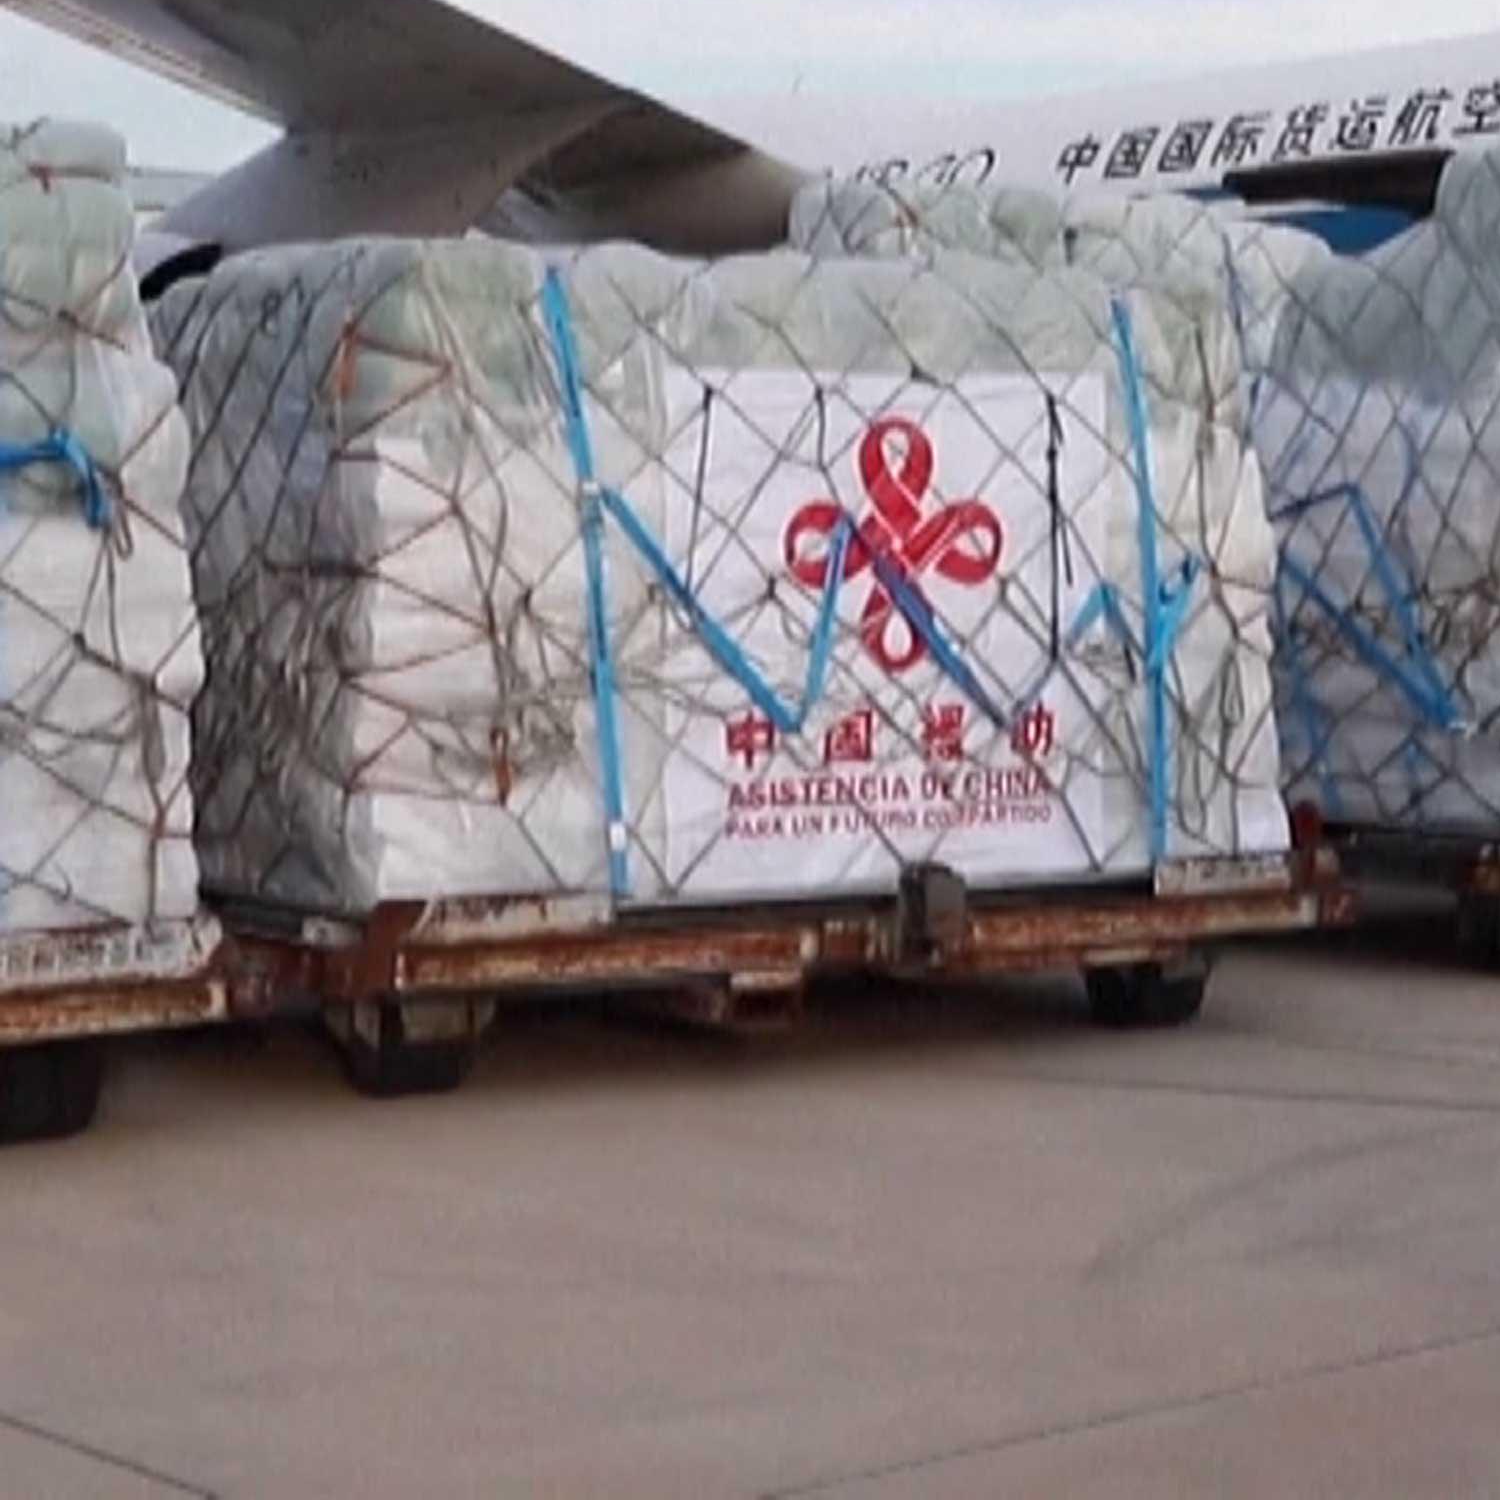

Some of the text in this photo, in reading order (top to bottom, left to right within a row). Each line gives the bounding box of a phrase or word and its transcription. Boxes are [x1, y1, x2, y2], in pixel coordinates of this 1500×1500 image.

[728, 773, 911, 809] ASISTENCIA
[963, 767, 1054, 800] CHINA
[725, 813, 783, 840] PARA
[791, 811, 823, 835] UN
